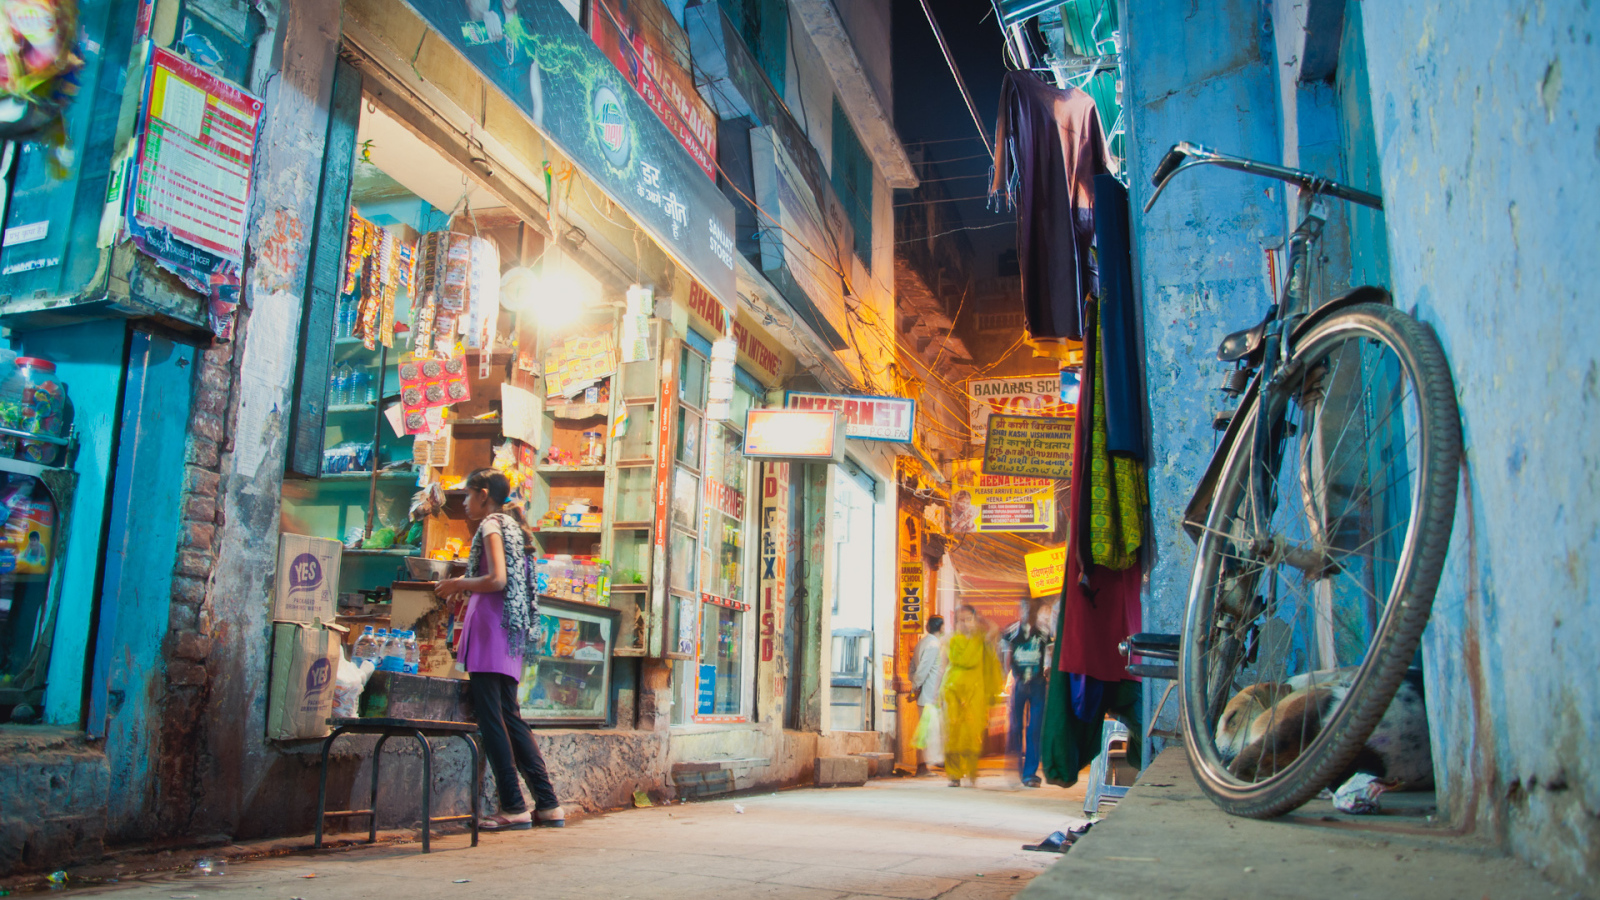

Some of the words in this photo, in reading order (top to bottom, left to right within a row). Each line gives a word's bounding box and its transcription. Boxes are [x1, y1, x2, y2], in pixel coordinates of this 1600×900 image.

[642, 81, 664, 114] FULL
[664, 108, 685, 140] FULL
[684, 135, 713, 174] MASALA
[640, 161, 660, 189] डर
[636, 181, 646, 198] के
[646, 189, 662, 208] आगे
[662, 192, 688, 228] जीत
[709, 218, 734, 254] SANJAY
[709, 236, 734, 271] STORES
[689, 280, 748, 353] BHAVSH
[974, 381, 1033, 396] BANARAS
[971, 404, 984, 419] of
[992, 429, 1007, 437] SHRI
[1008, 430, 1028, 439] KASHI
[1030, 432, 1072, 440] VISHWANATH
[980, 475, 1010, 487] HEENA
[1013, 476, 1050, 487] CENTRE
[1014, 487, 1024, 495] ALL
[295, 561, 317, 583] YES
[901, 574, 922, 582] SCHOOL
[902, 587, 920, 622] YOGA
[760, 587, 775, 662] ISD
[311, 664, 329, 687] YES
